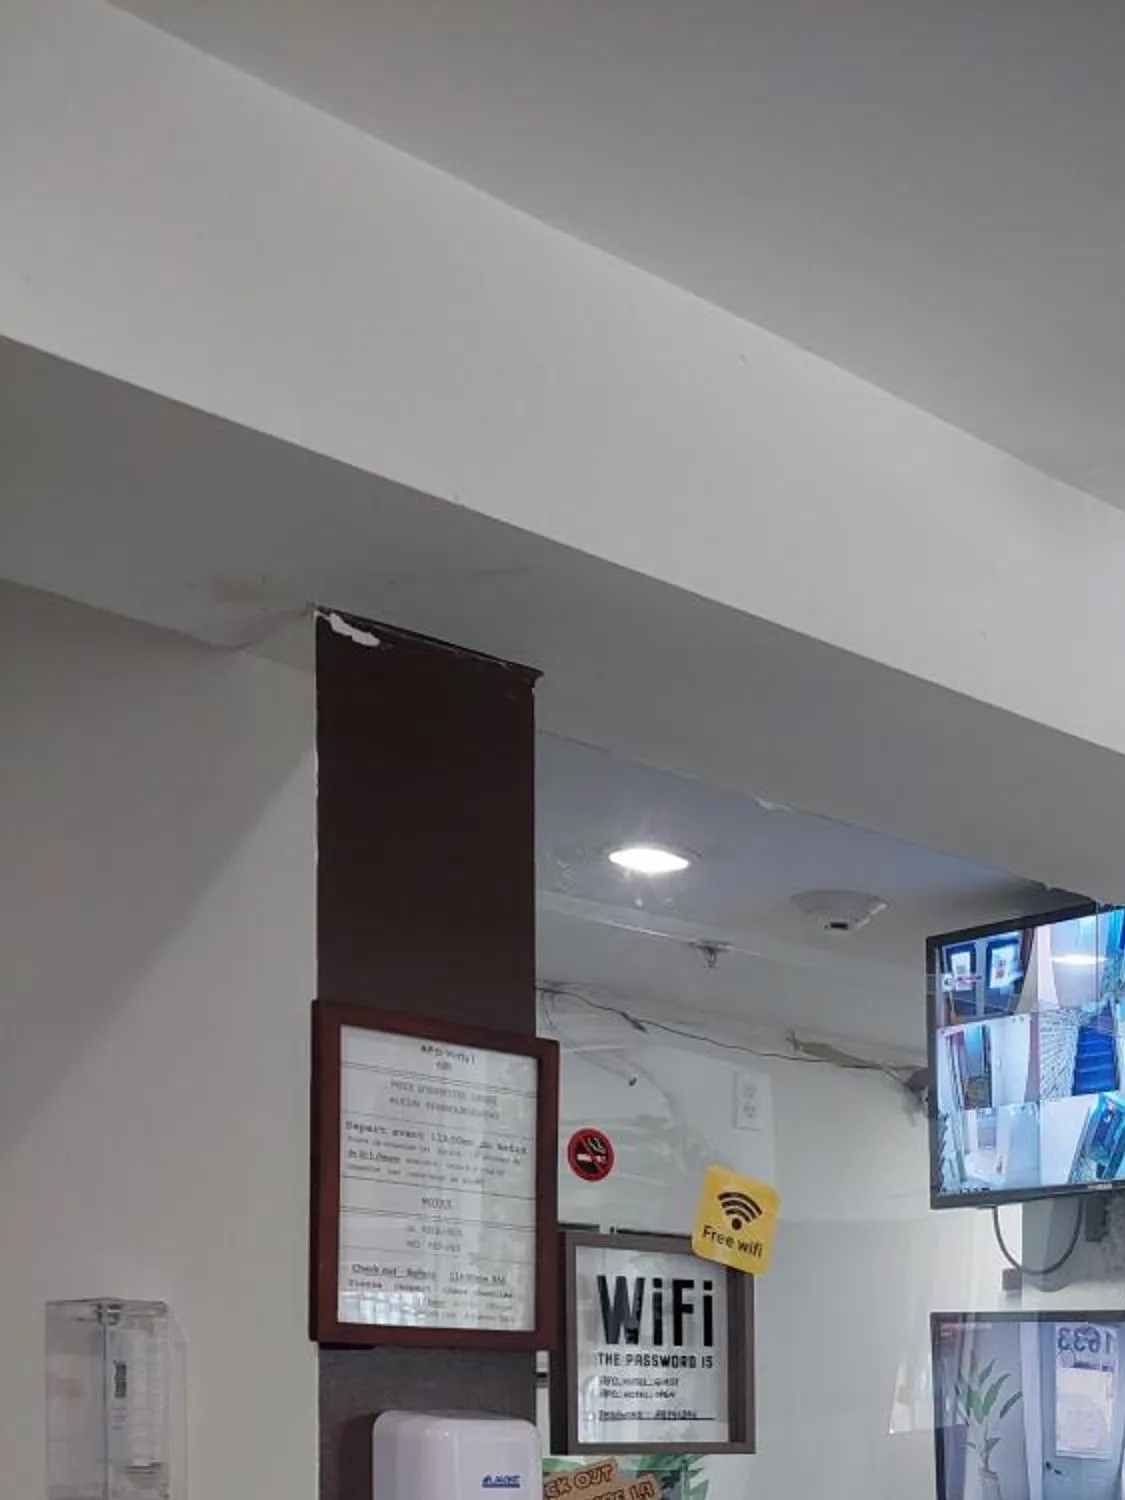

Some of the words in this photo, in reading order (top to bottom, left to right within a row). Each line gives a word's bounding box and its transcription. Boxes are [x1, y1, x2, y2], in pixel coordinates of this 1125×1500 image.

[702, 1224, 734, 1249] Free
[737, 1239, 763, 1258] wifi
[597, 1275, 713, 1347] WiFi
[598, 1352, 621, 1367] THE
[625, 1353, 697, 1369] PASSWORD
[700, 1354, 713, 1369] IS
[573, 1464, 613, 1490] OUT
